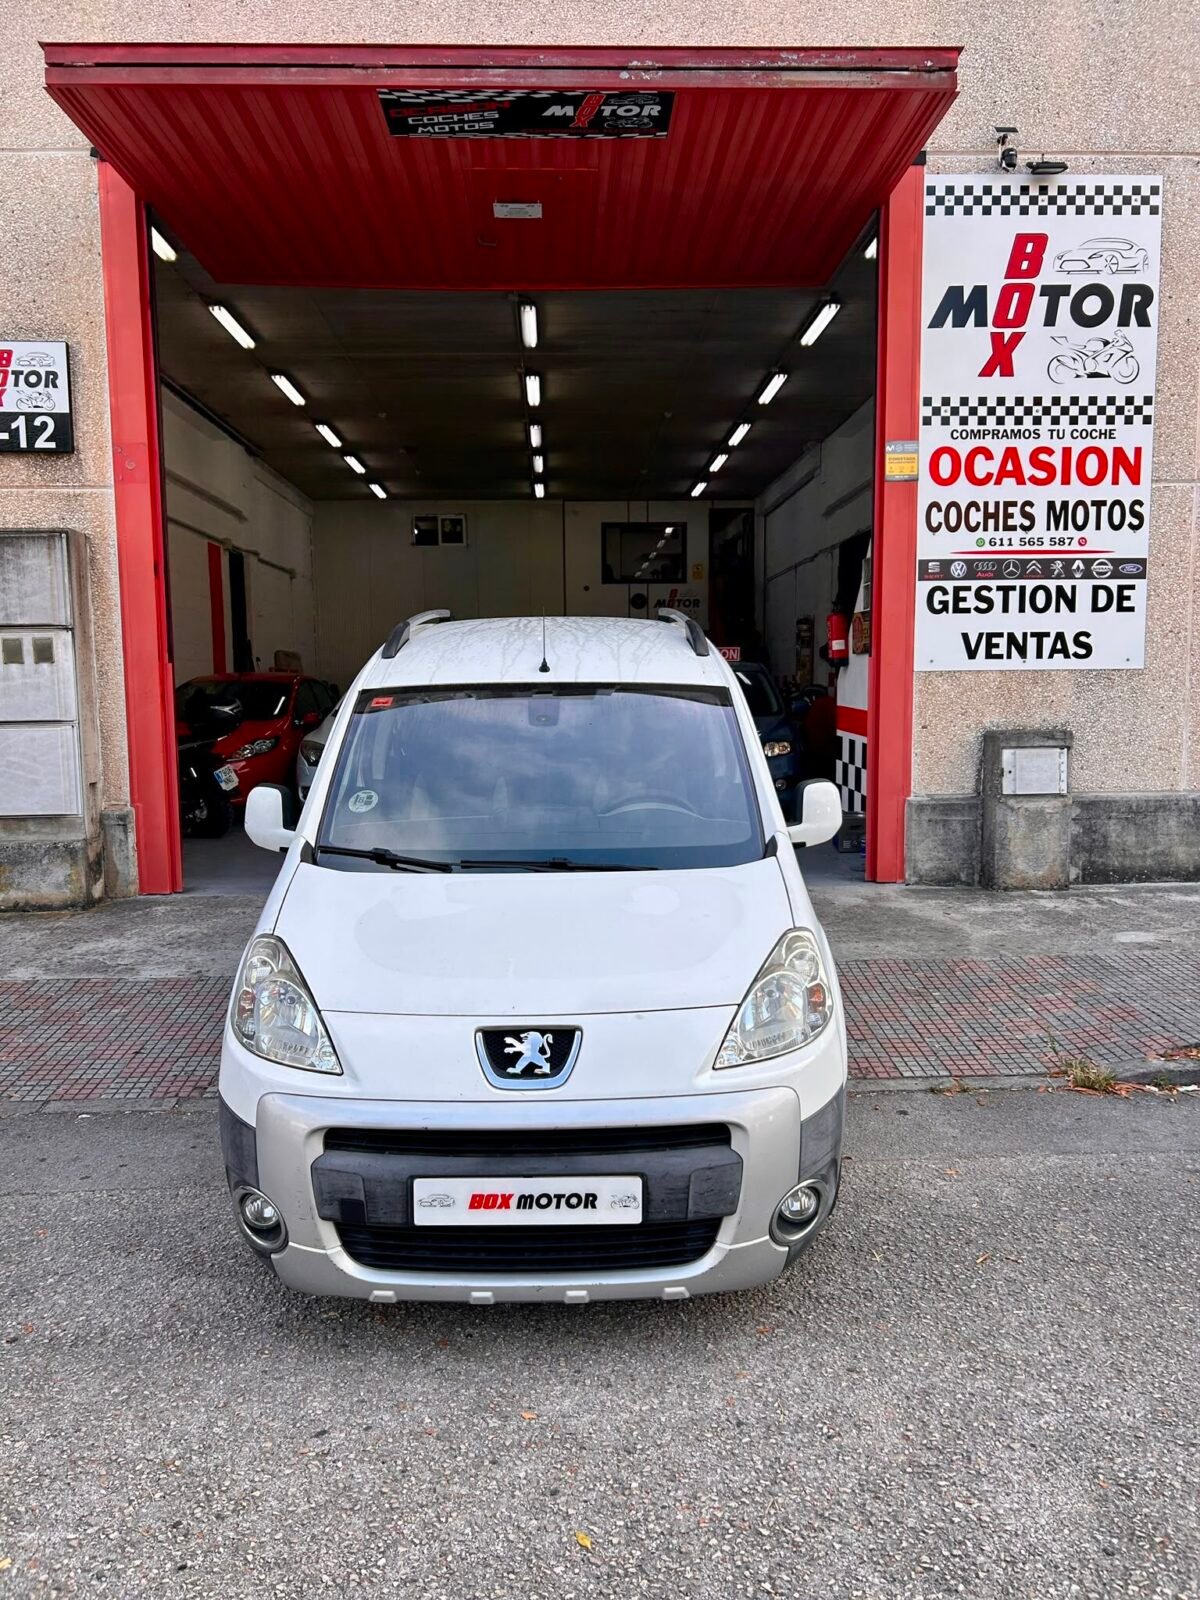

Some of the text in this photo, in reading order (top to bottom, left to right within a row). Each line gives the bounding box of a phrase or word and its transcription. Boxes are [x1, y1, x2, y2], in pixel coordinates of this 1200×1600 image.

[408, 111, 499, 125] COCHES
[417, 121, 494, 133] MOTOS
[928, 283, 1154, 328] MOTOR
[977, 233, 1049, 377] BOX
[950, 428, 1117, 440] COMPRAMOS TU COCHE
[929, 446, 1142, 486] OCASION
[925, 499, 1145, 533] COCHES MOTOS
[988, 536, 1074, 547] 611 565 587
[926, 584, 1136, 614] GESTION DE
[720, 649, 738, 659] ON
[961, 631, 1093, 660] VENTAS
[468, 1193, 598, 1210] BOX MOTOR
